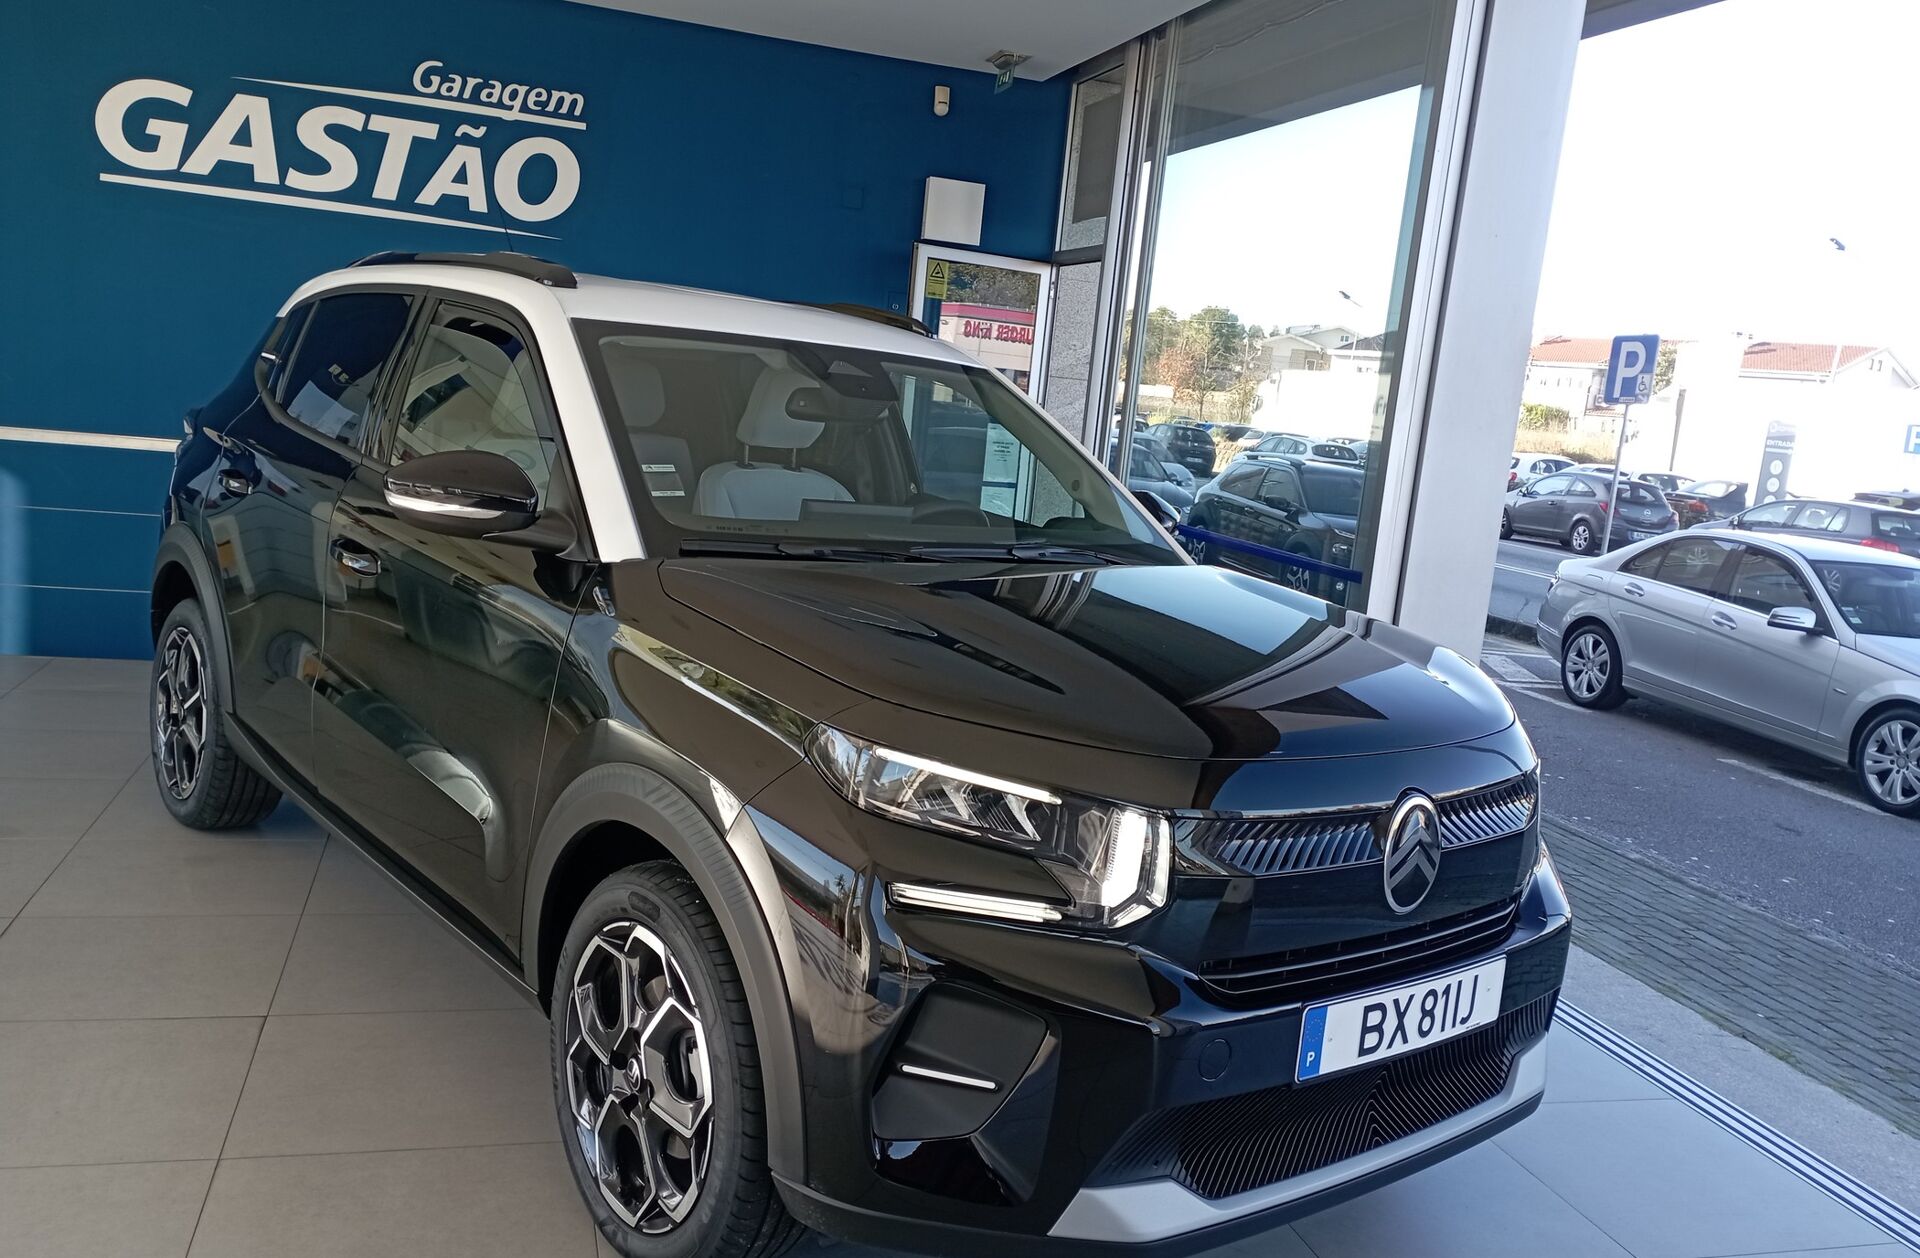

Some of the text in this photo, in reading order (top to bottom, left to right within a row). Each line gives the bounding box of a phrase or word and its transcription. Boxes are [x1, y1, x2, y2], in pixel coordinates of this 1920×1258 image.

[412, 60, 584, 119] Garagem
[94, 78, 581, 222] GASTÃO
[1613, 341, 1647, 398] P
[1306, 1051, 1315, 1067] P
